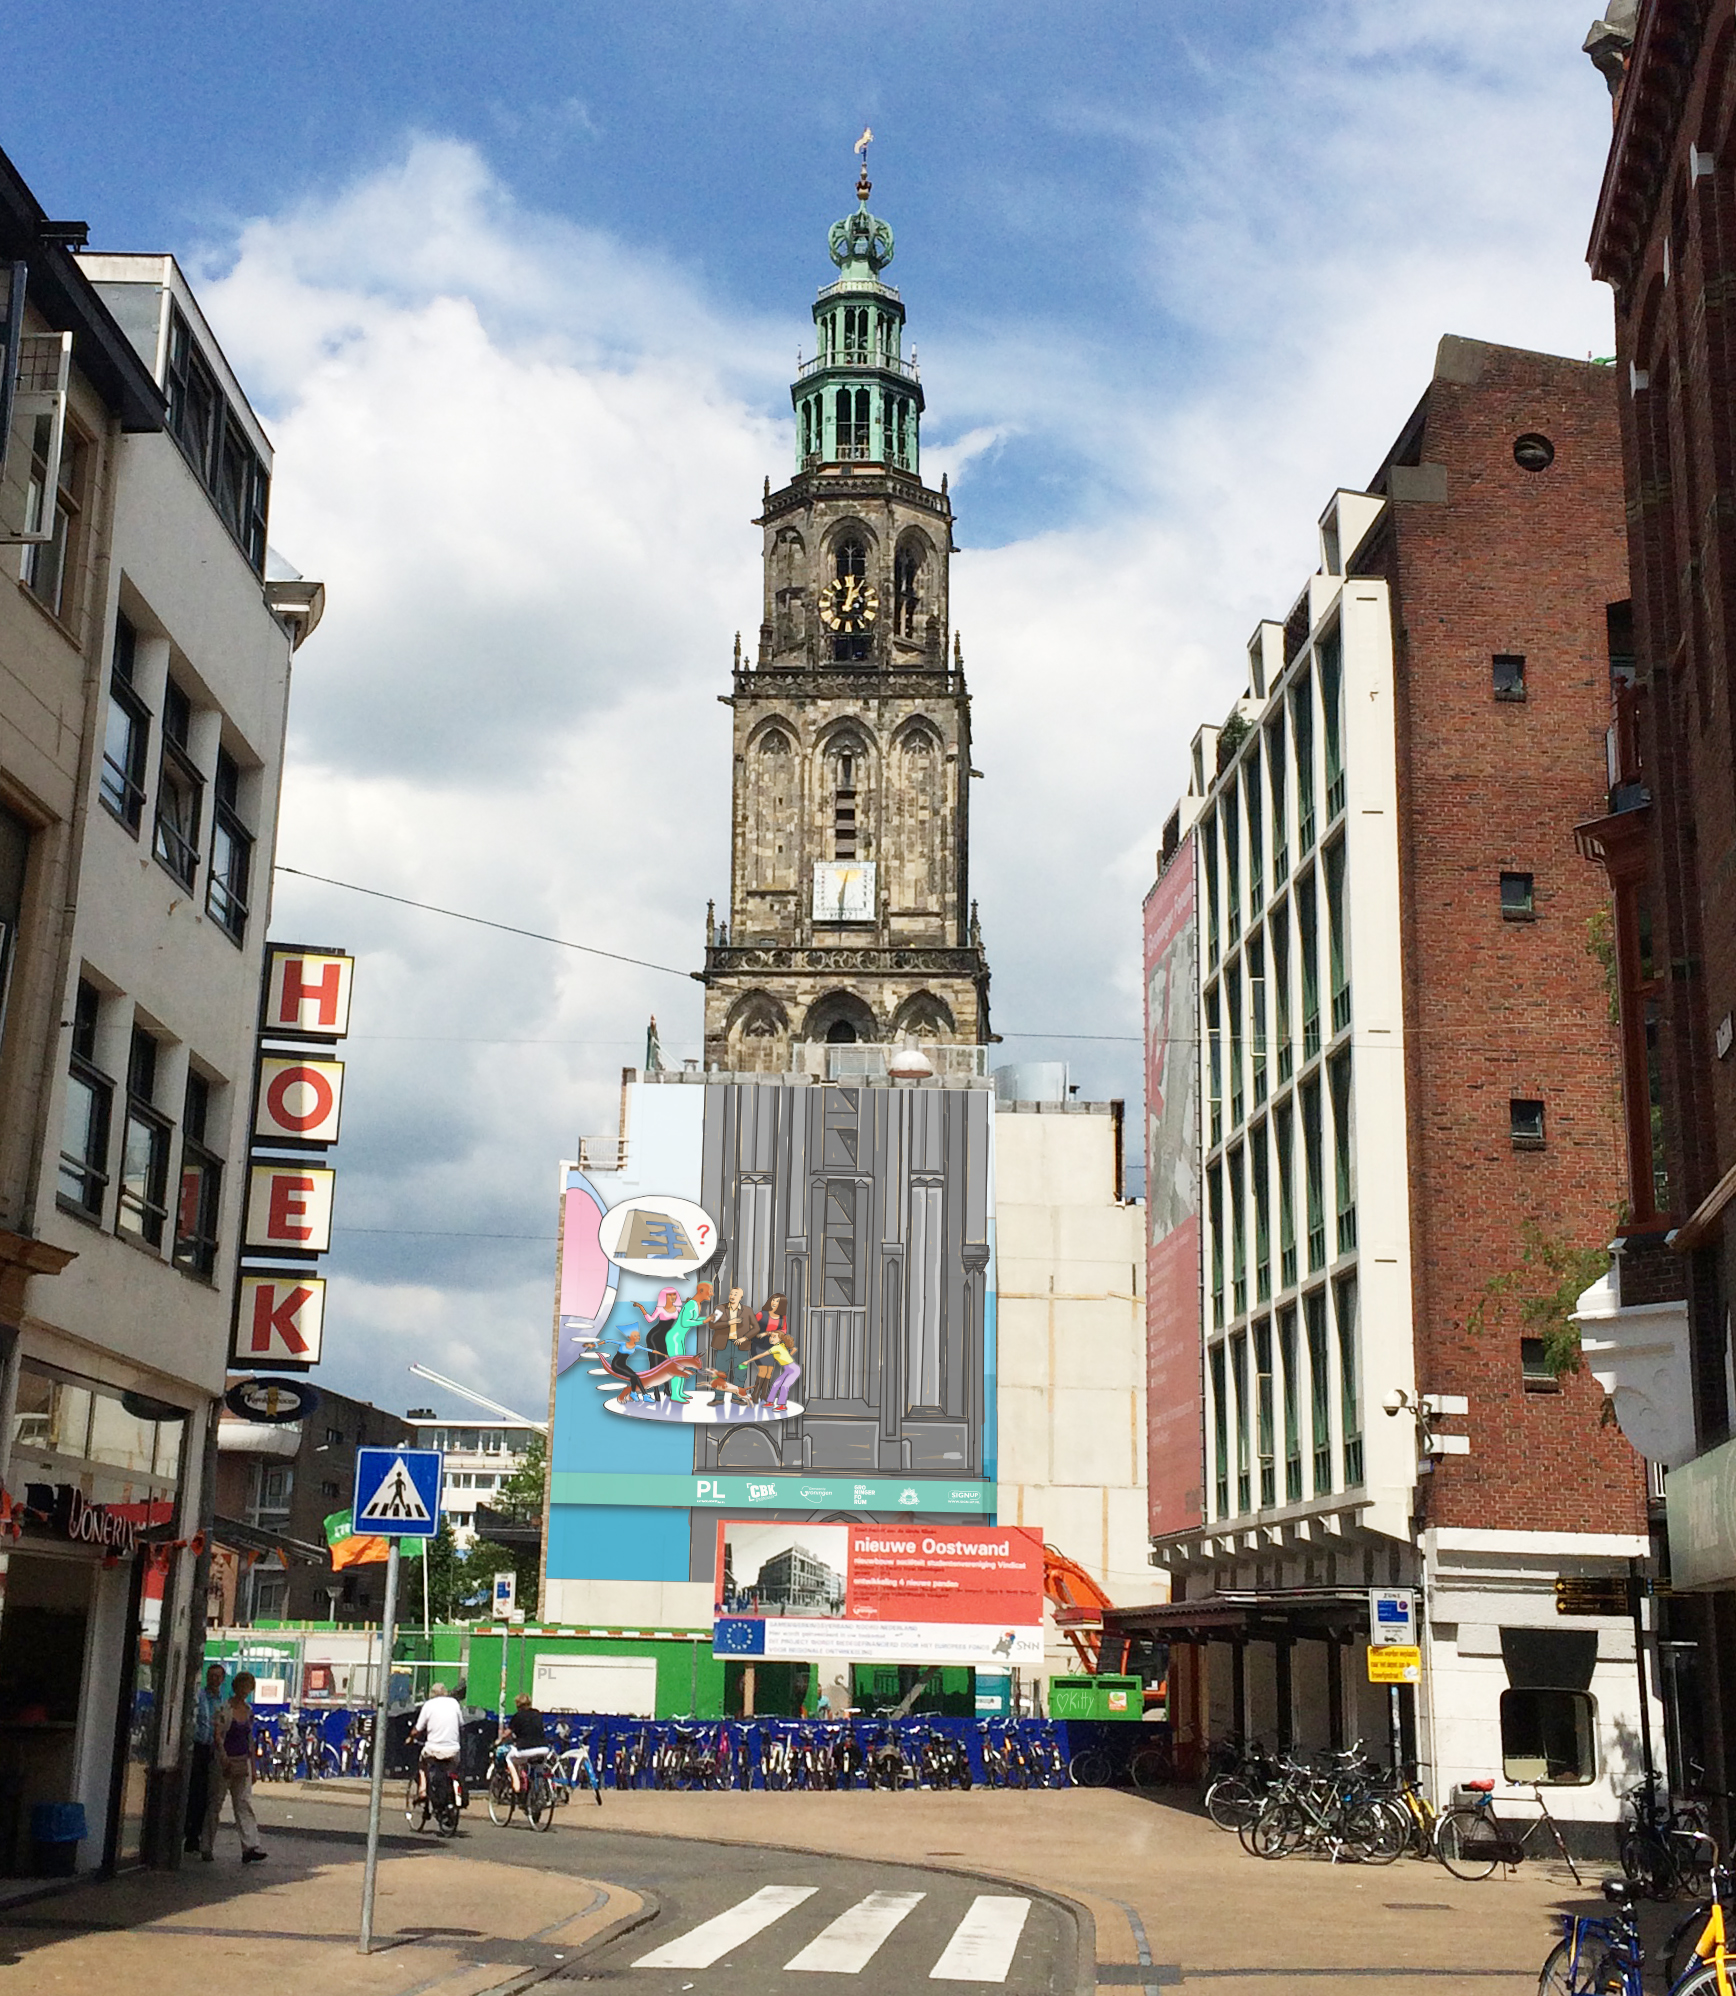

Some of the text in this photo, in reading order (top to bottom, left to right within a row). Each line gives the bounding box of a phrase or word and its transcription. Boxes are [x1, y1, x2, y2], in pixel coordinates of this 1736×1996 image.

[251, 959, 341, 1354] HOEK
[697, 1224, 710, 1245] ?
[696, 1480, 726, 1499] PL
[750, 1484, 776, 1498] CBK
[951, 1490, 979, 1498] SIGNUP
[854, 1536, 1010, 1557] nieuwe Oostwand
[1016, 1640, 1041, 1651] SNN
[537, 1667, 557, 1680] PL
[1069, 1691, 1095, 1717] Kitty
